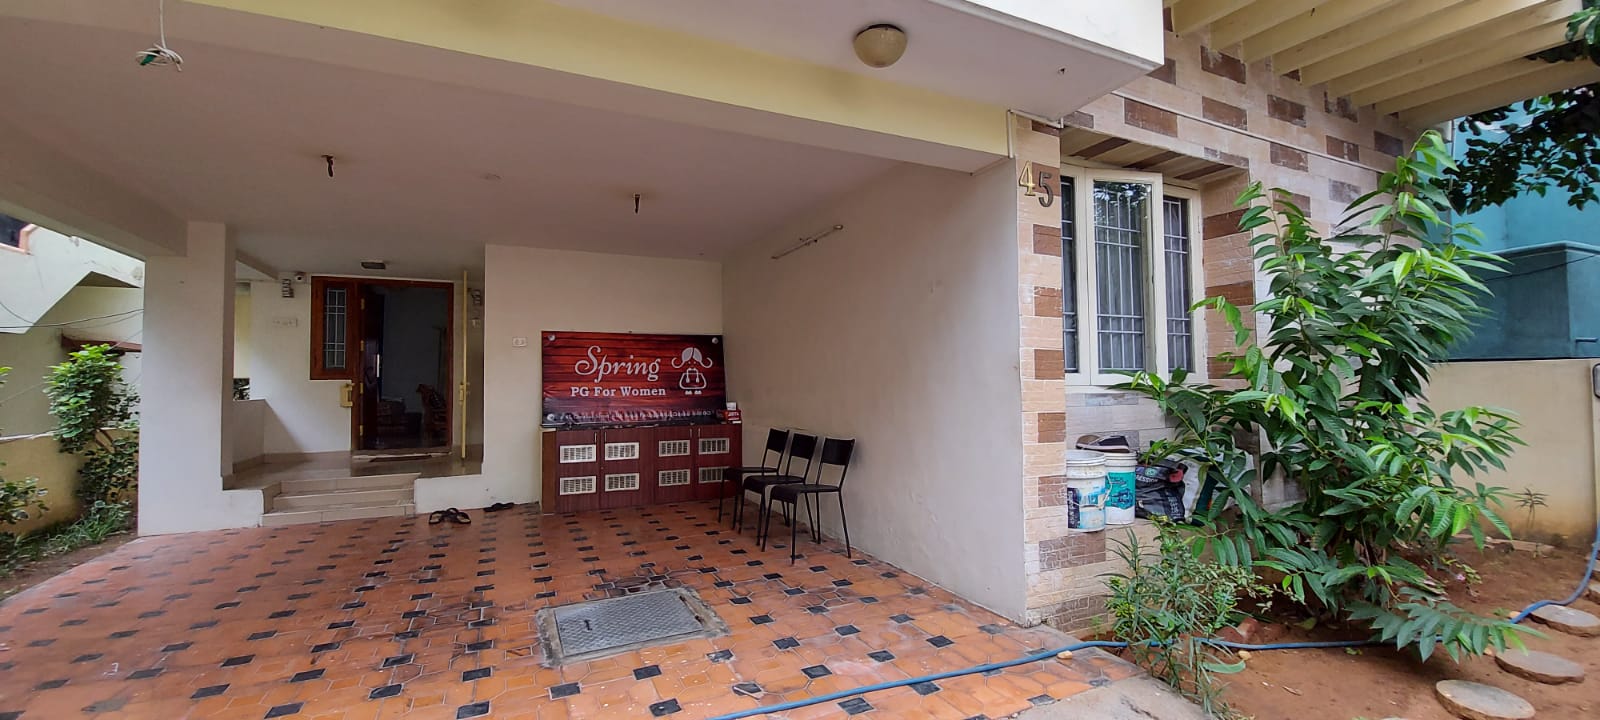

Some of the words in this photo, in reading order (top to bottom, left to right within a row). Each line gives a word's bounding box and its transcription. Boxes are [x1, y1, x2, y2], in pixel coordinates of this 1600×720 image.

[1018, 159, 1054, 208] 45
[574, 346, 660, 383] Spring
[571, 387, 590, 396] PG
[594, 387, 616, 397] For
[620, 387, 666, 396] Women
